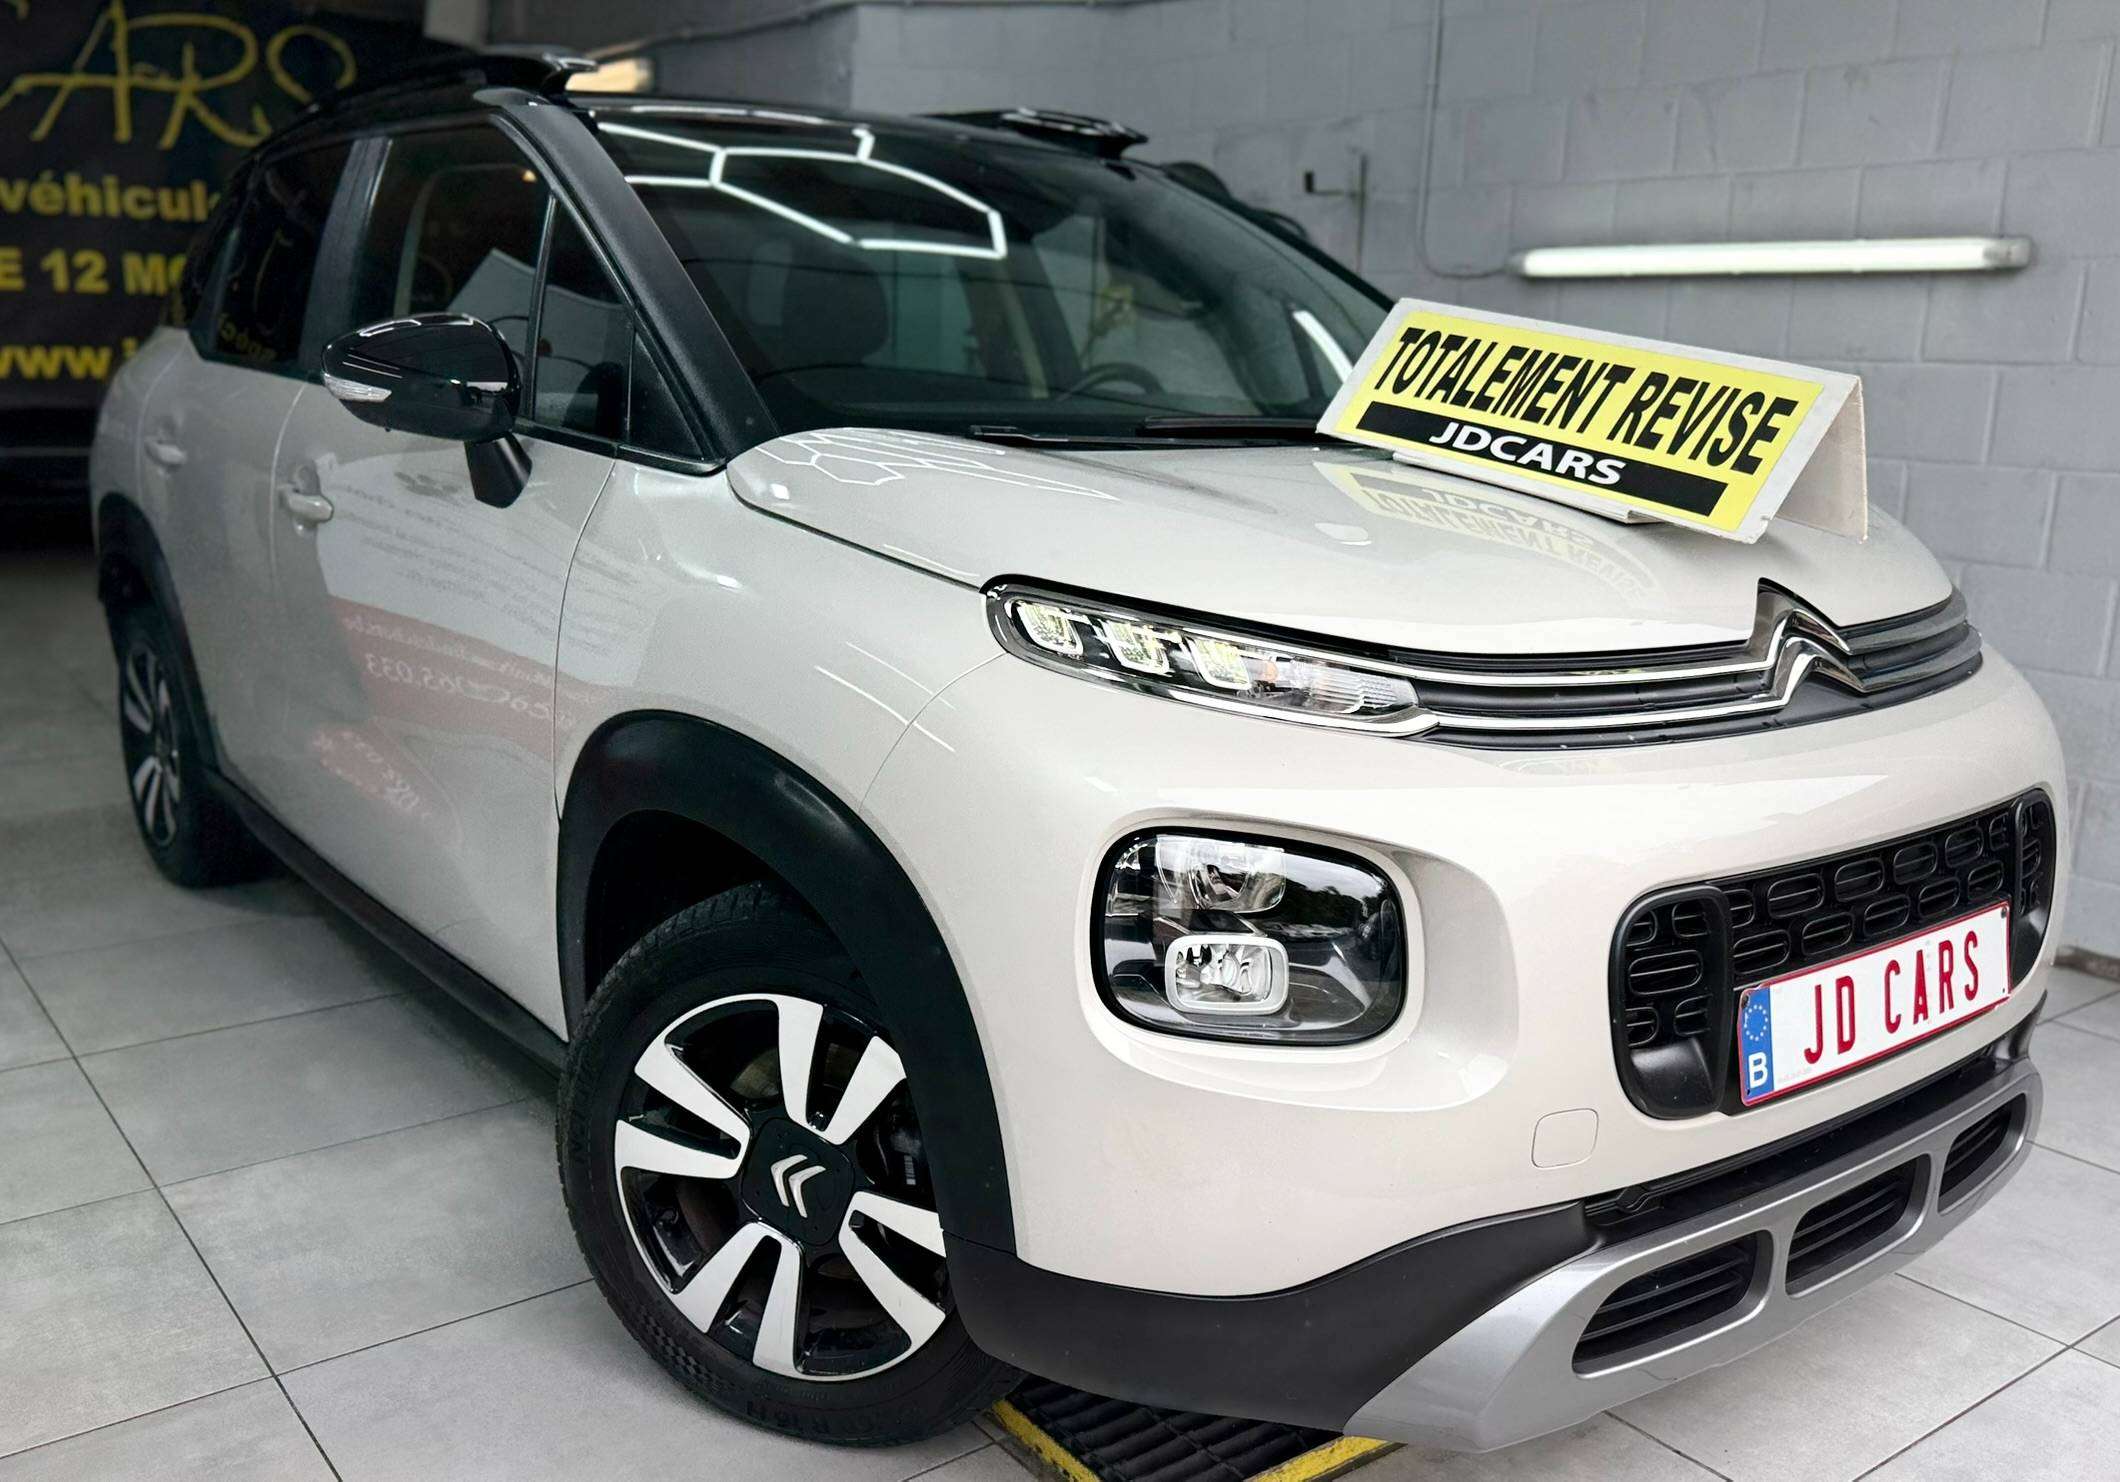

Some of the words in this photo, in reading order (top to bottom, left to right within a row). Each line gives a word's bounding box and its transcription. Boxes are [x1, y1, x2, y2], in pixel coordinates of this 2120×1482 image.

[0, 0, 357, 149] ARS
[0, 169, 221, 222] véhicul
[40, 248, 109, 294] 12
[1375, 326, 1636, 434] TOTALEMENT
[1607, 371, 1799, 475] REVISE
[1428, 421, 1627, 486] JDCARS
[1804, 975, 1856, 1065] JD
[1884, 930, 1979, 1034] CARS
[1748, 1051, 1768, 1088] B
